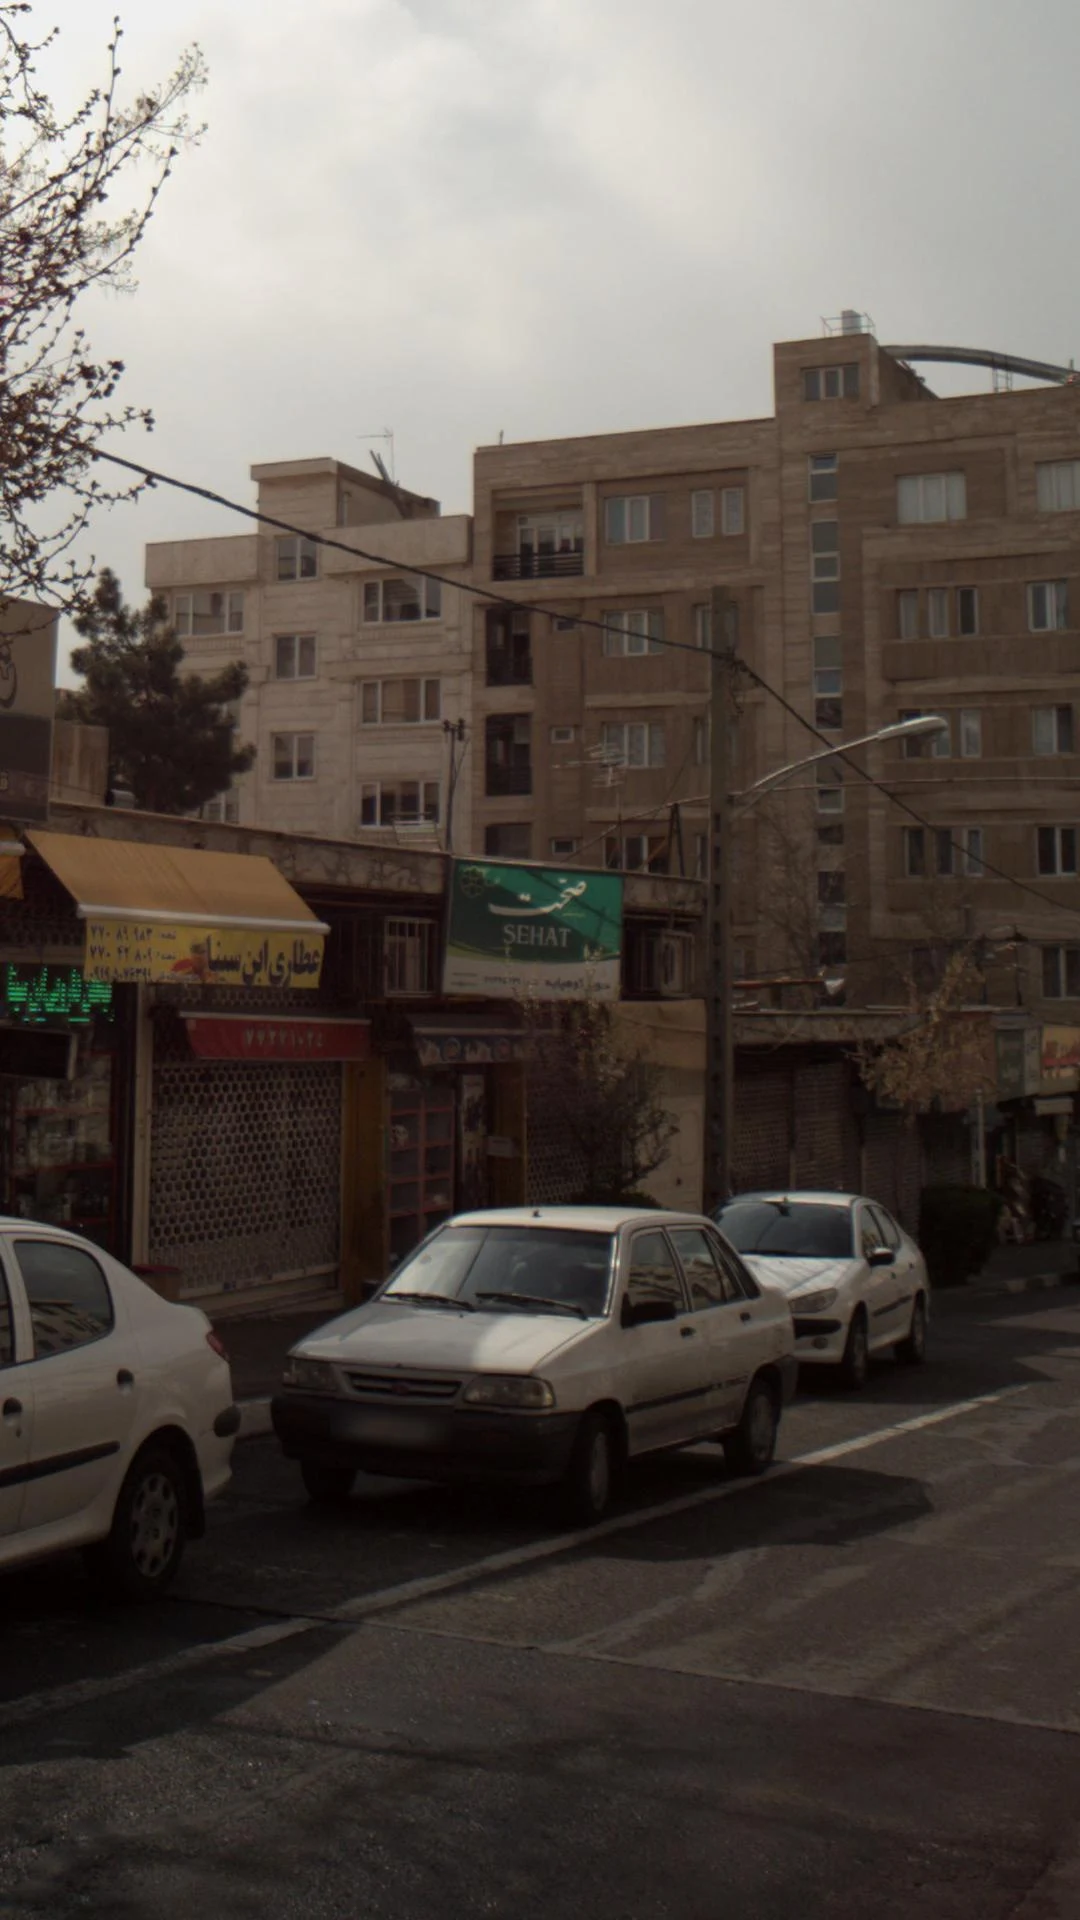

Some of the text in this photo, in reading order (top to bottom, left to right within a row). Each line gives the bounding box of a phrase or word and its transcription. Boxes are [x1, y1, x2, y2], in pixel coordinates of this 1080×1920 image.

[503, 924, 572, 948] SEHAT
[206, 935, 320, 987] عطاری ابن سینا
